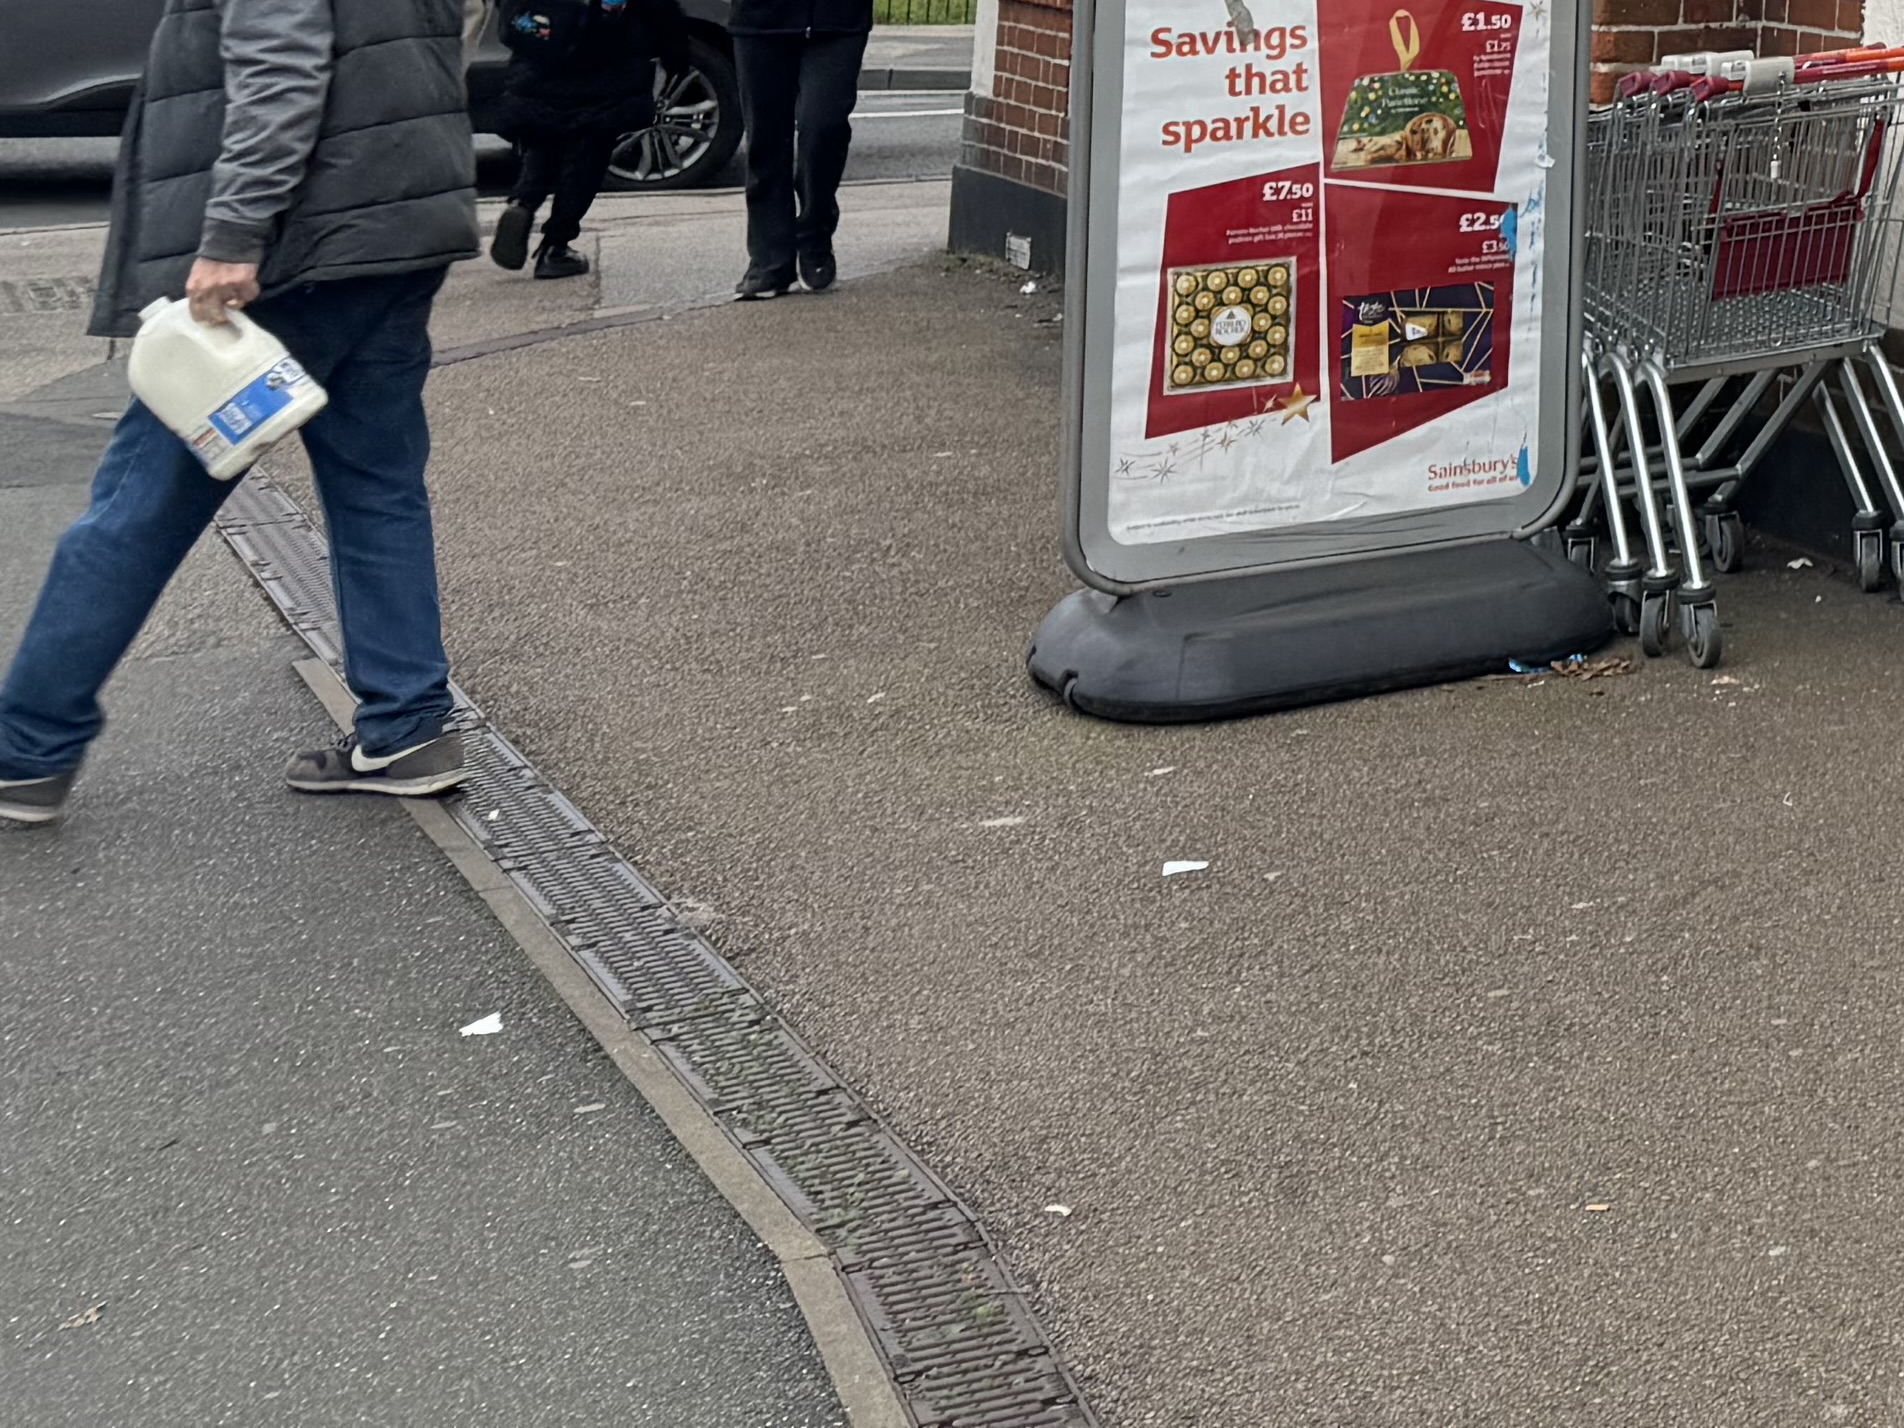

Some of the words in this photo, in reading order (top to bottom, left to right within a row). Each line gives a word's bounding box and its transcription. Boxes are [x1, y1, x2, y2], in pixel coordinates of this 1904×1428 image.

[1461, 12, 1511, 31] £1.50
[1150, 21, 1308, 60] Savings
[1225, 62, 1308, 97] that
[1162, 104, 1310, 153] sparkle
[1262, 181, 1313, 201] £7.50
[1292, 208, 1313, 222] £11
[1459, 212, 1504, 232] £2.5
[1428, 454, 1517, 480] Sainsbury's
